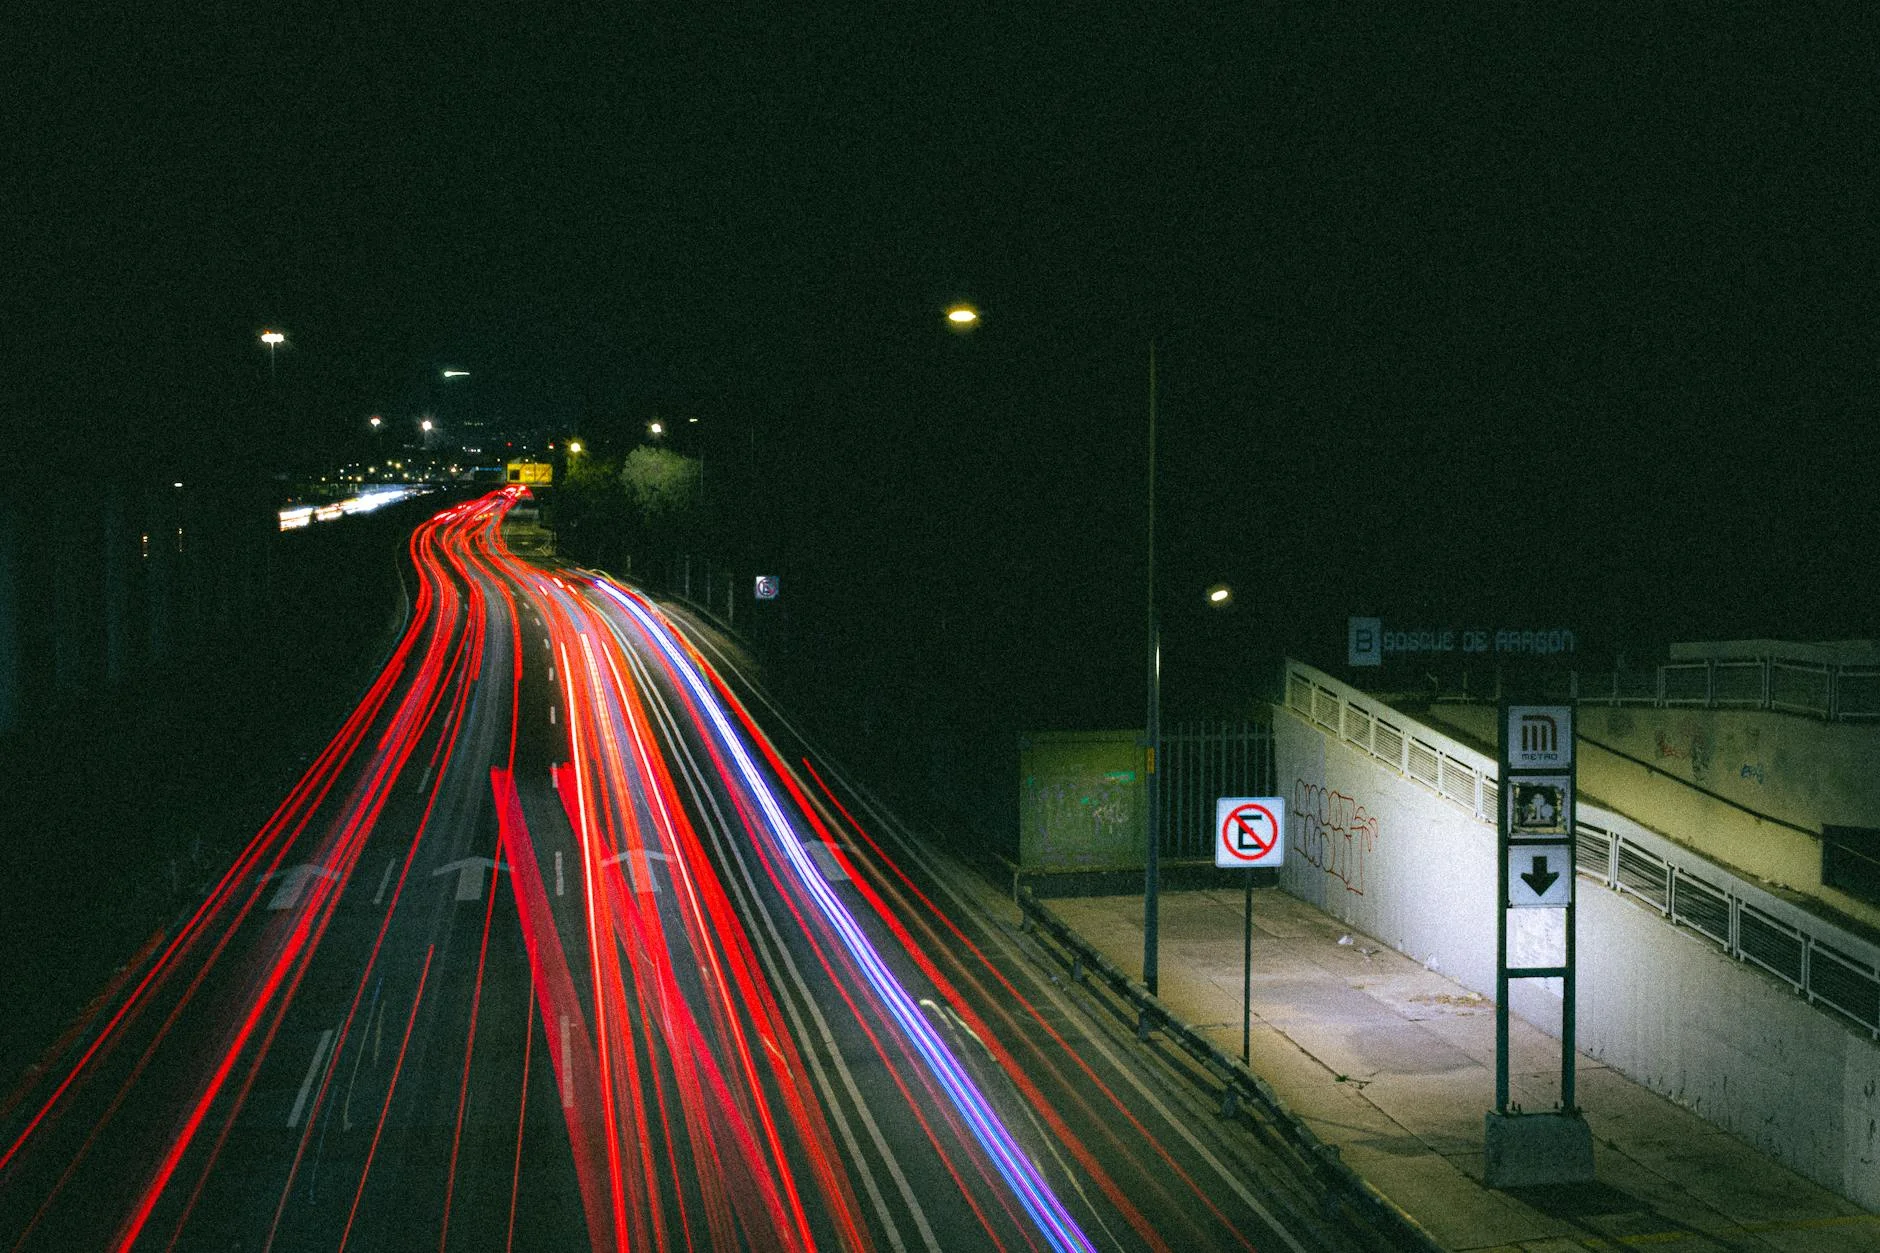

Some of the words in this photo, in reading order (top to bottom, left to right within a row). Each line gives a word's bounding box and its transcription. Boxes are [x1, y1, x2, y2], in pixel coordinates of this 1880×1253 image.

[1356, 630, 1373, 652] B
[1463, 631, 1489, 652] DE
[1521, 753, 1558, 761] METRO
[1238, 815, 1262, 849] E
